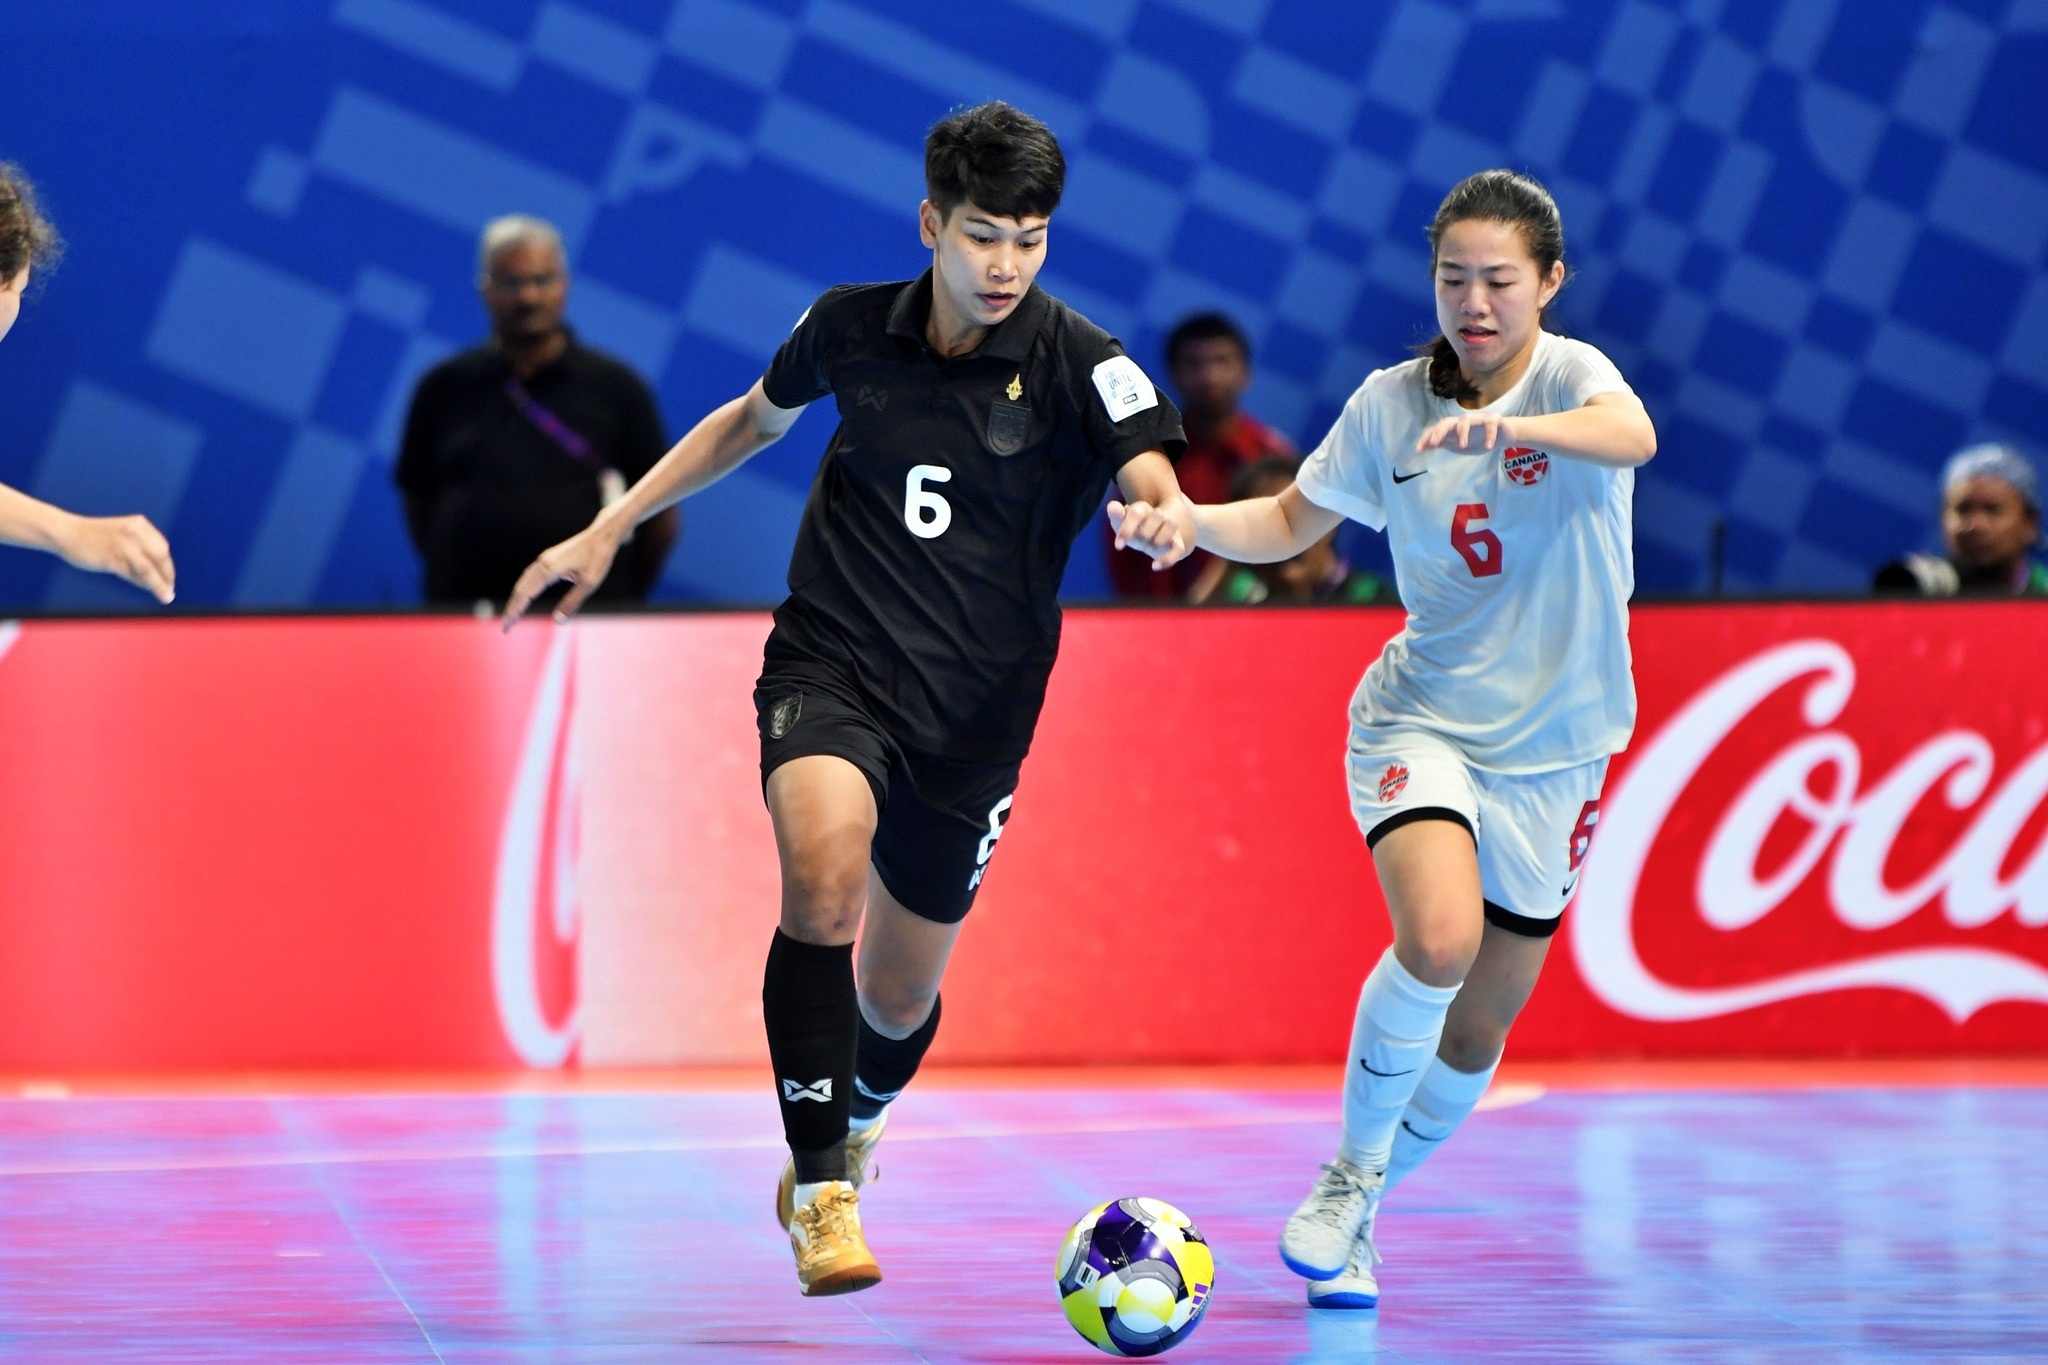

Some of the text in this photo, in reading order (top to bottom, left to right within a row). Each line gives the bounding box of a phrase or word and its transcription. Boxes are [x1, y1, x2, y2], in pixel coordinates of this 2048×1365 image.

[1504, 452, 1548, 470] CANADA
[904, 464, 952, 539] 6
[1450, 502, 1503, 578] 6
[1568, 799, 1601, 873] 6
